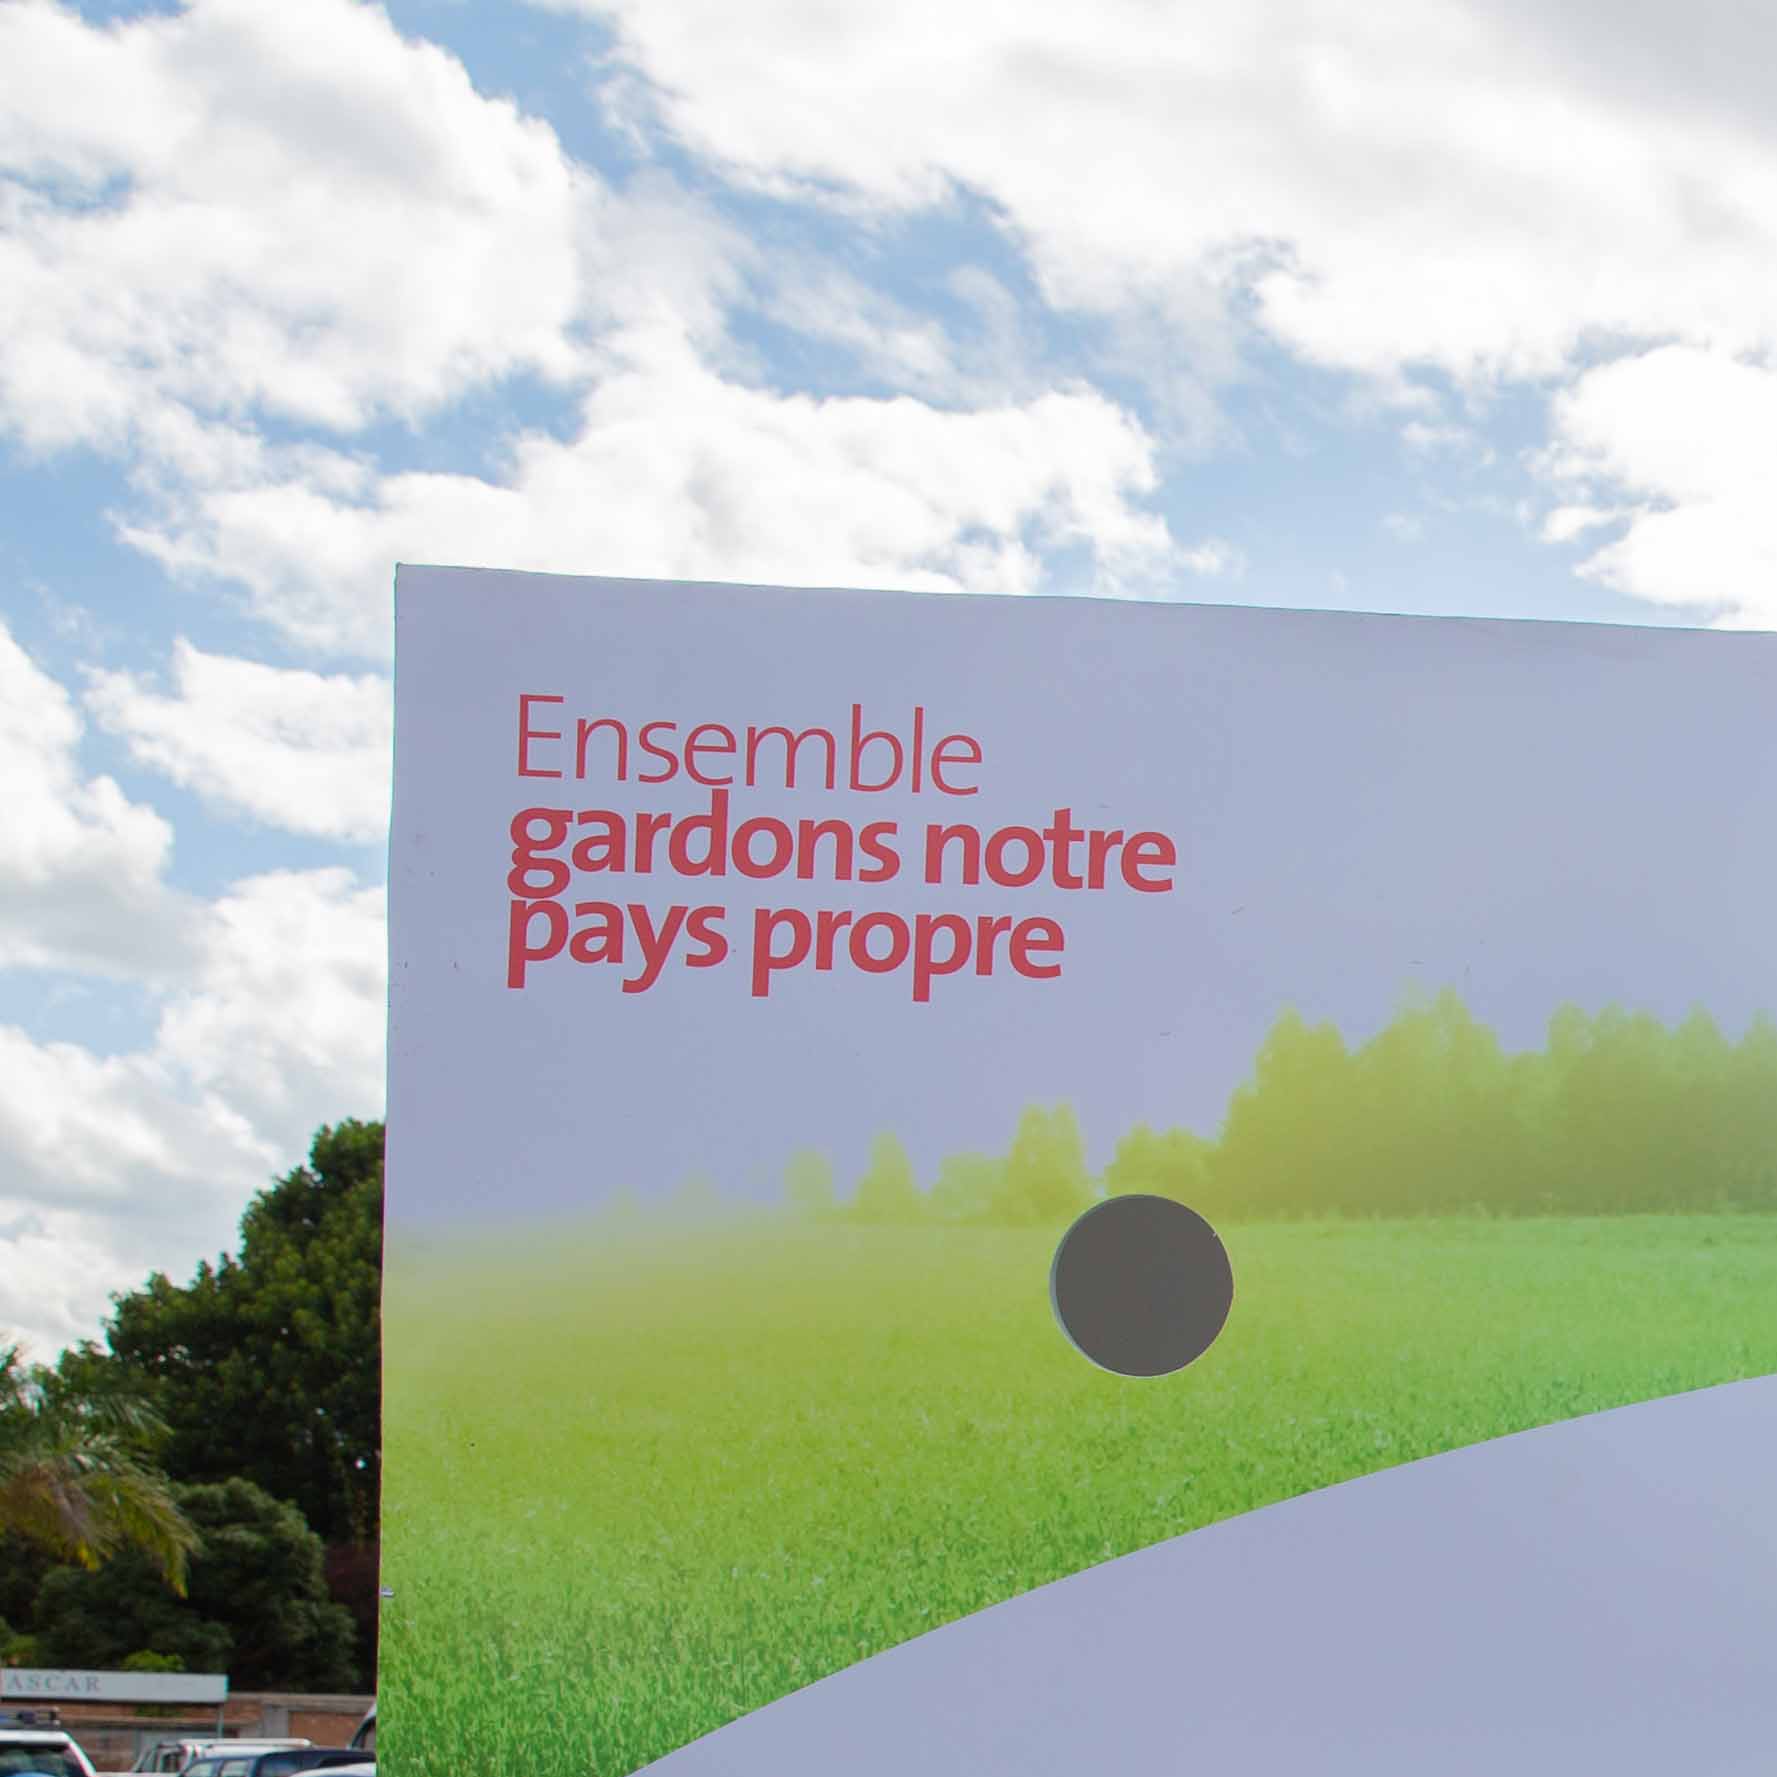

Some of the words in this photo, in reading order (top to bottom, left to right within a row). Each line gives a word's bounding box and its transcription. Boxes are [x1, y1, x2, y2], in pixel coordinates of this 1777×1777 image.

[516, 693, 983, 796] Ensemble
[506, 788, 901, 899] gardons
[924, 807, 1177, 893] notre
[506, 897, 729, 994] pays
[751, 907, 1066, 1003] propre
